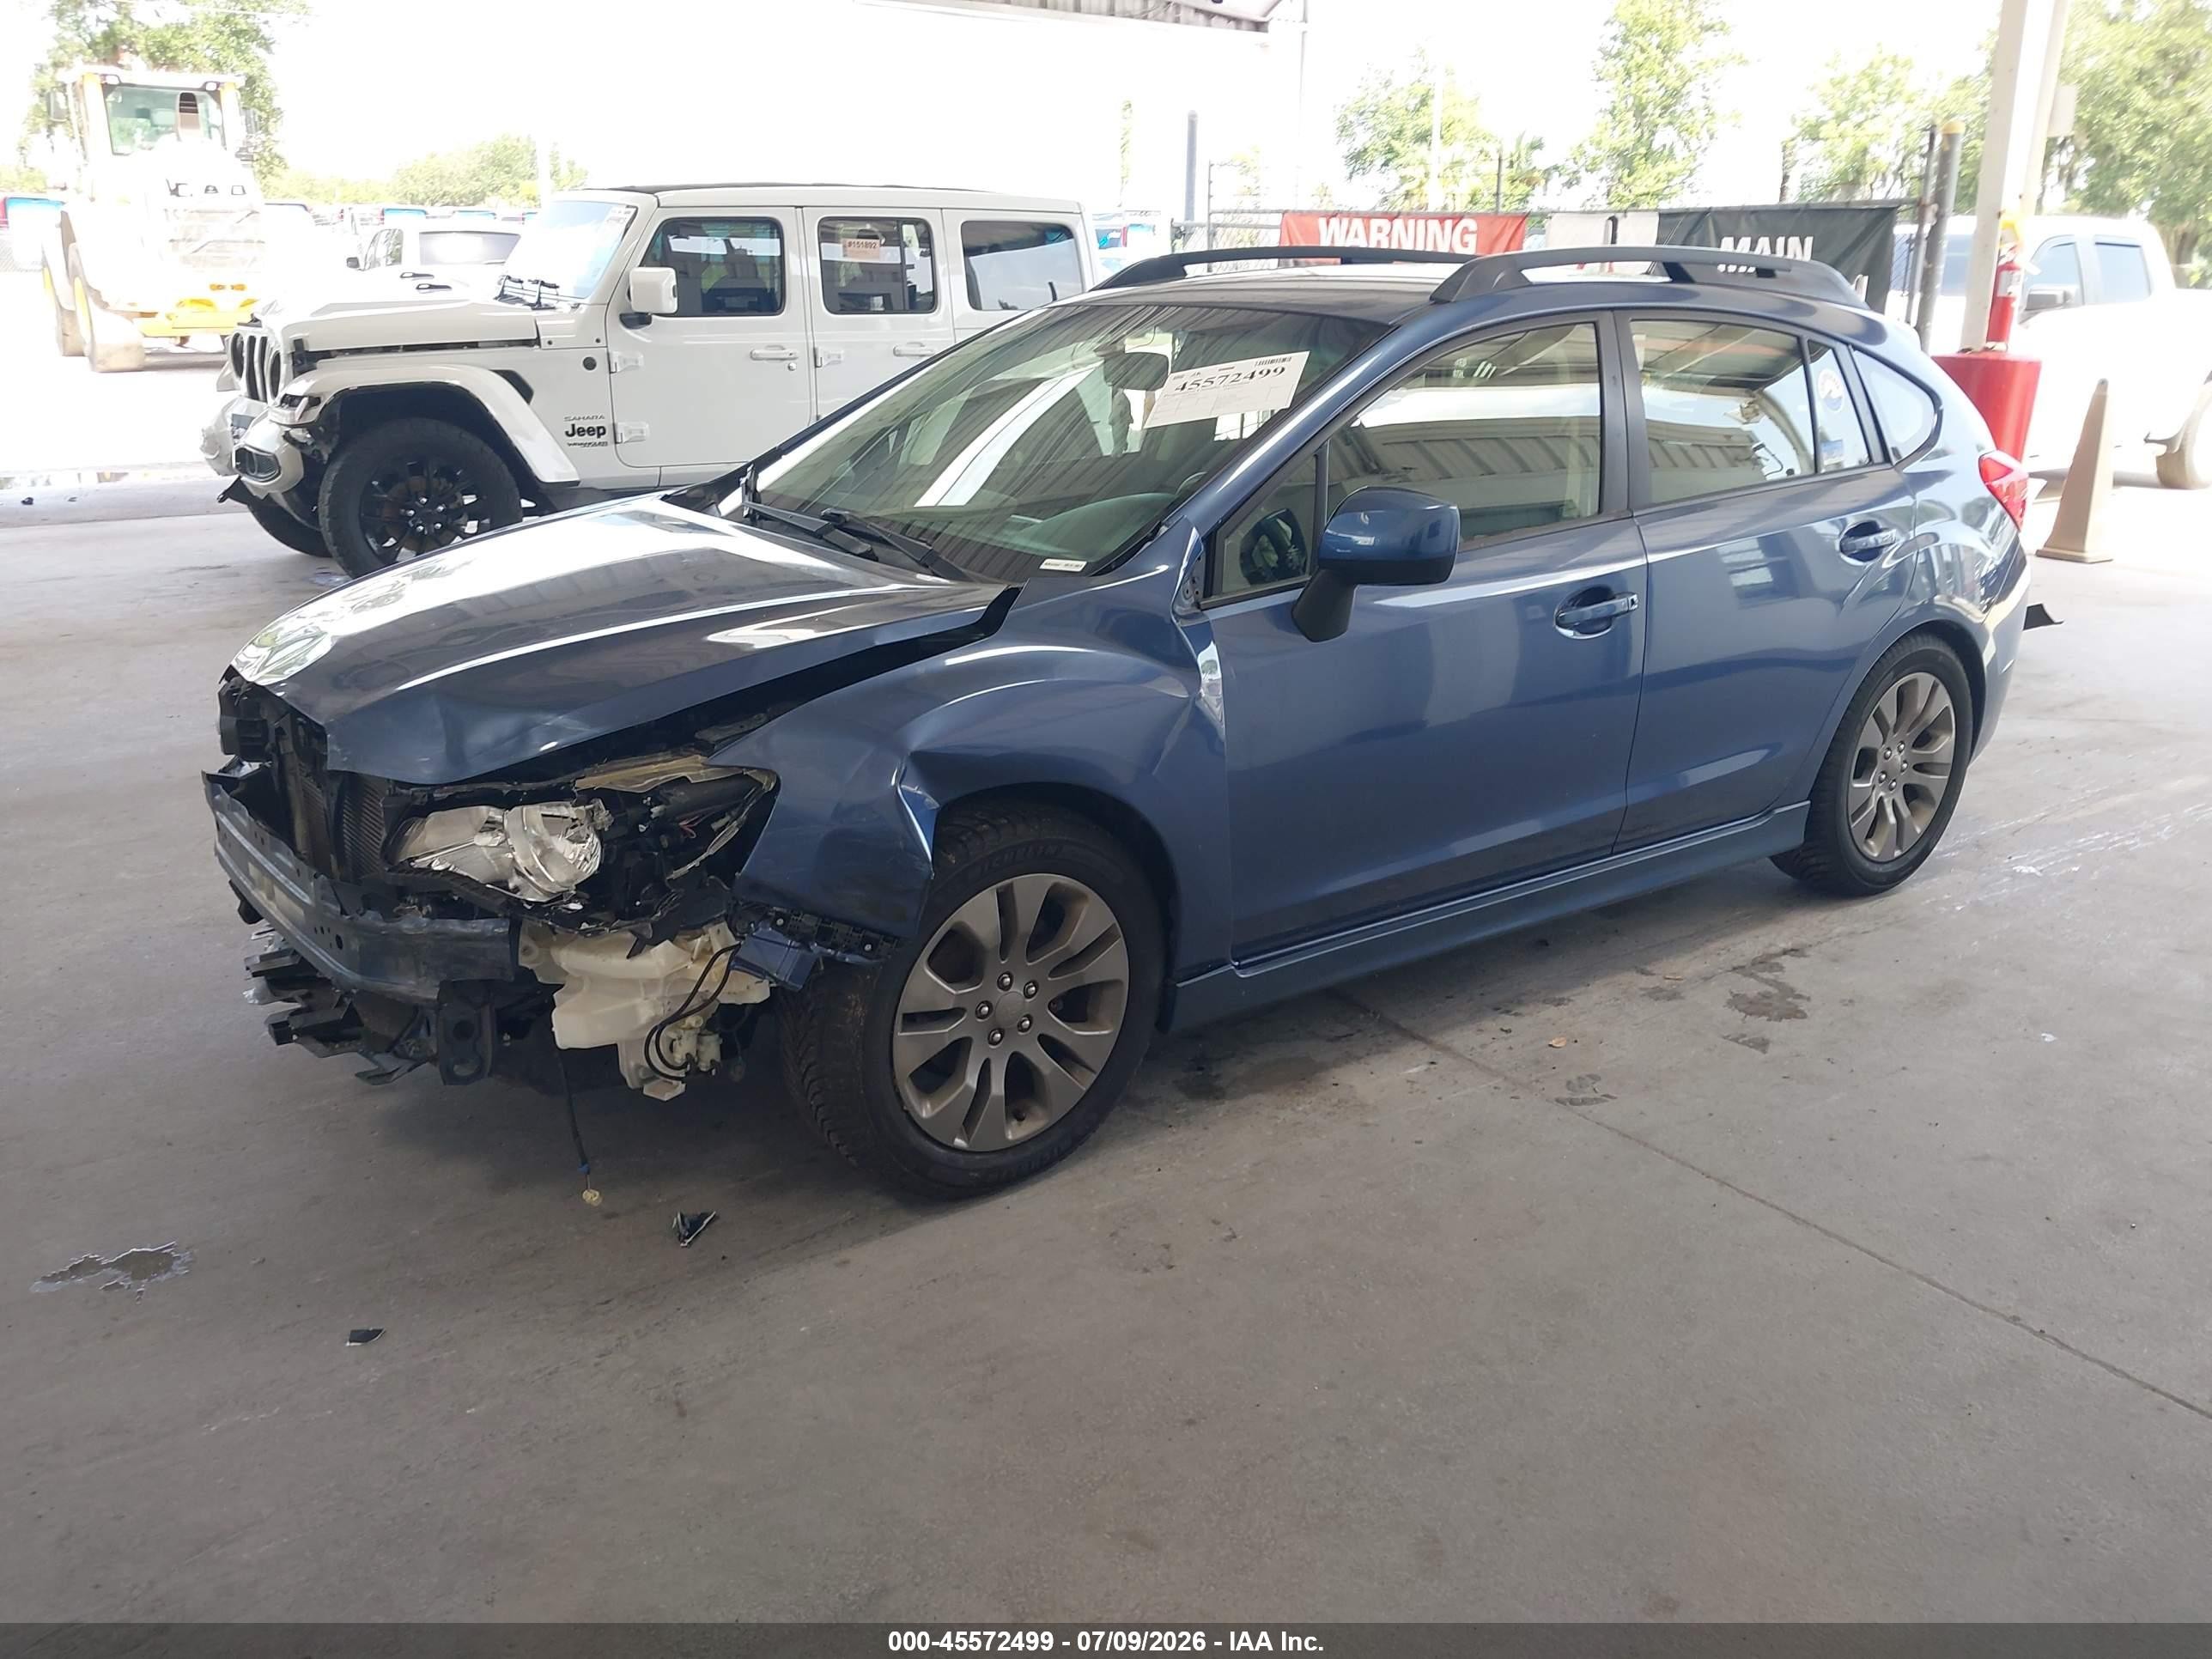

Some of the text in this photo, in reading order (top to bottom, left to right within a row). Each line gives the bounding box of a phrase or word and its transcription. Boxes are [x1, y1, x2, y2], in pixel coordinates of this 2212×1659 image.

[1317, 216, 1478, 255] WARNING
[1174, 366, 1285, 392] 45572499
[564, 423, 606, 439] Jeep
